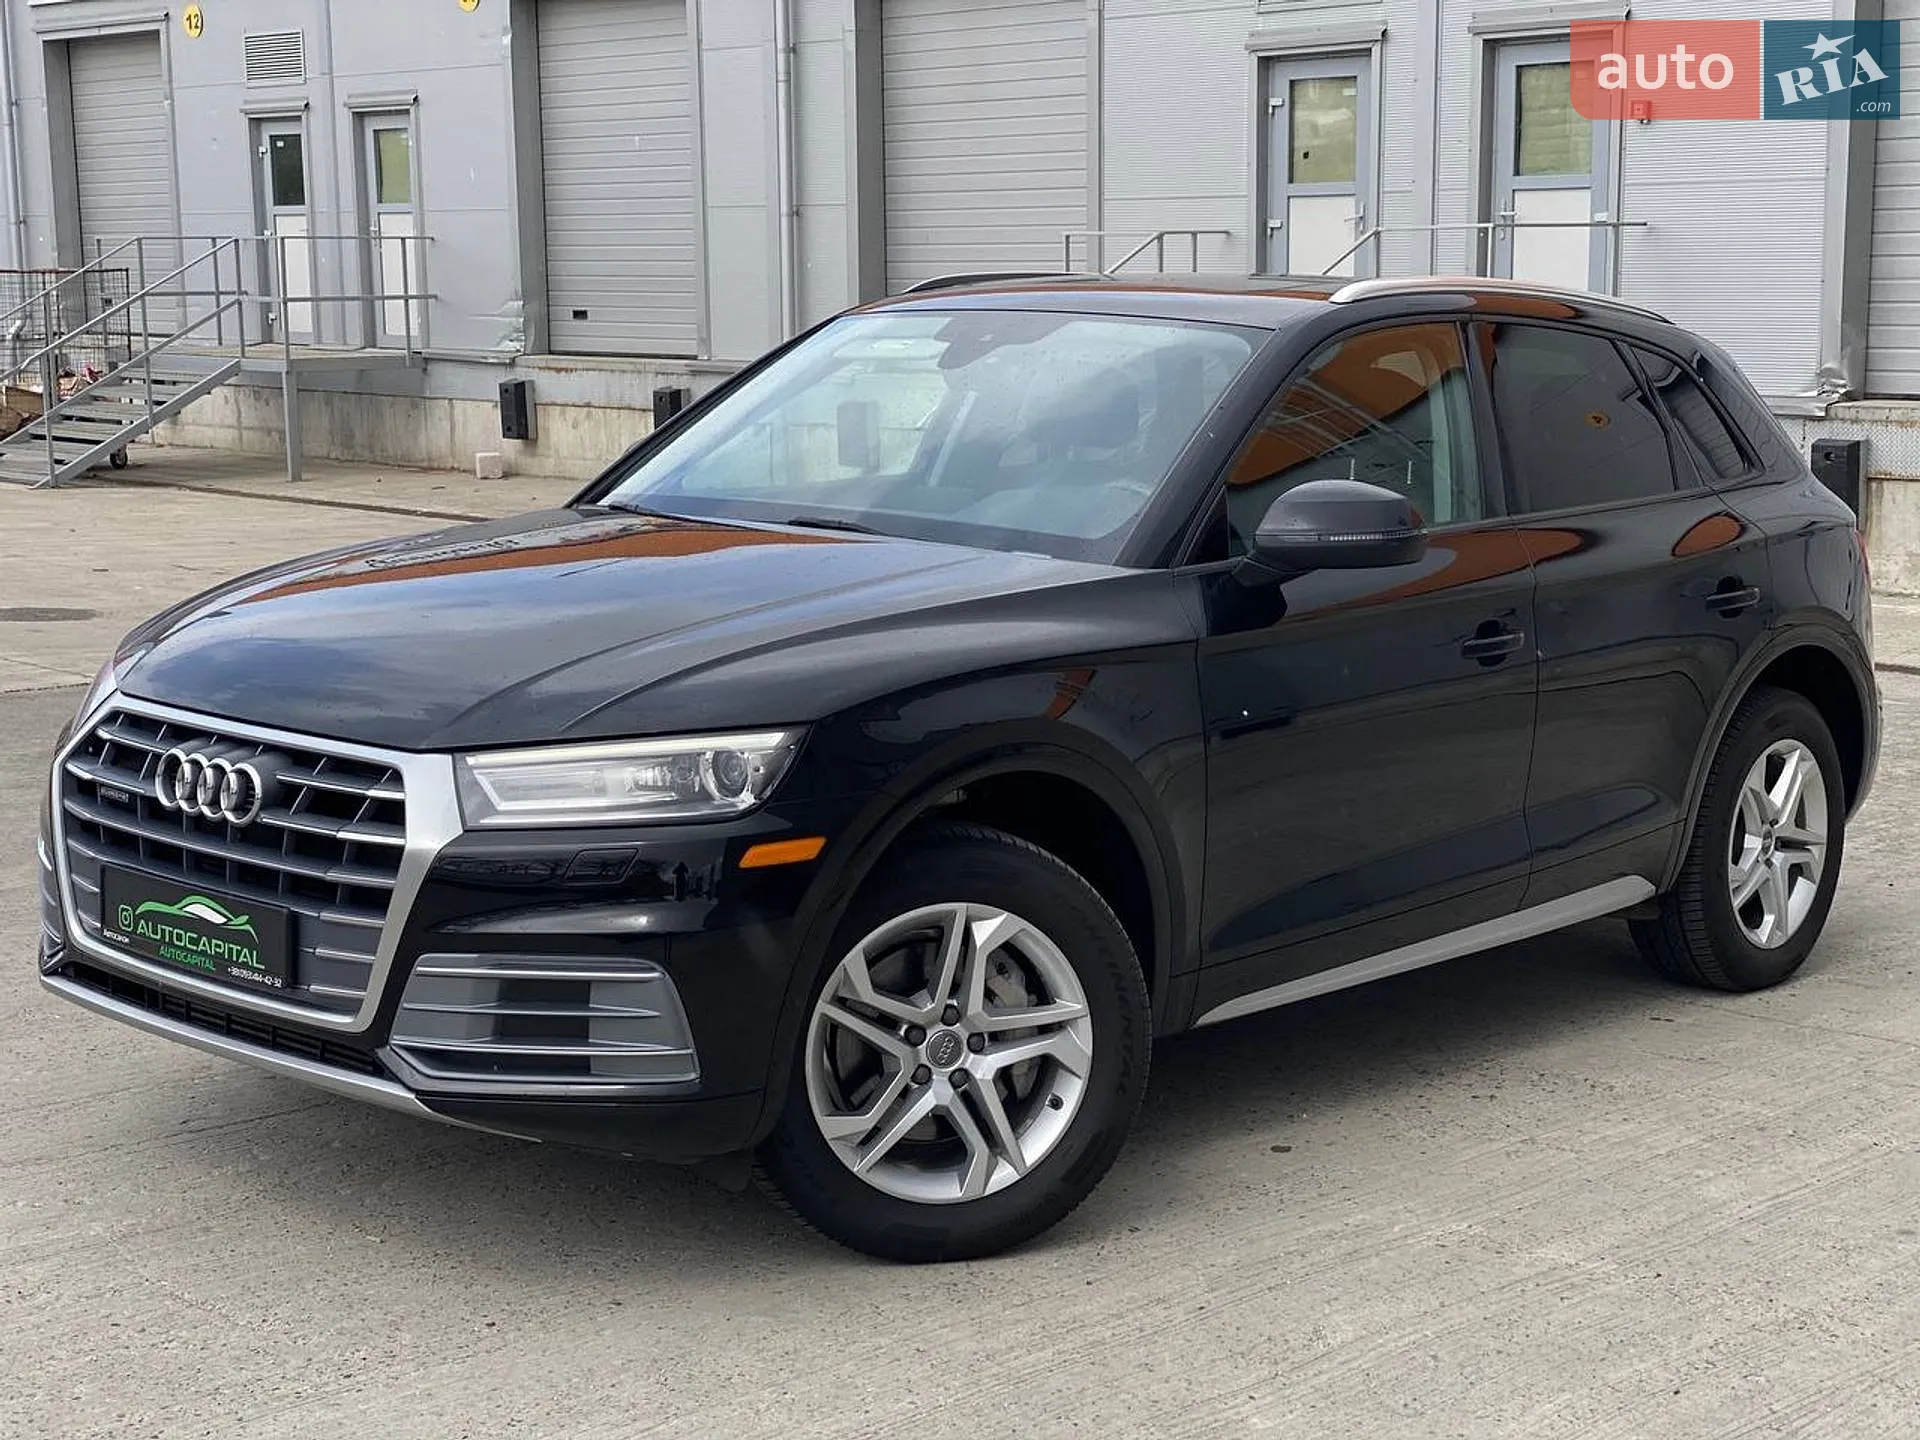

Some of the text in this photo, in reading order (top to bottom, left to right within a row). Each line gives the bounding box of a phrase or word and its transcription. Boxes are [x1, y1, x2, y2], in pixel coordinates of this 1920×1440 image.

[186, 13, 199, 30] 12
[136, 919, 266, 970] AUTOCAPITAL
[158, 945, 217, 973] AUTOCAPITAL
